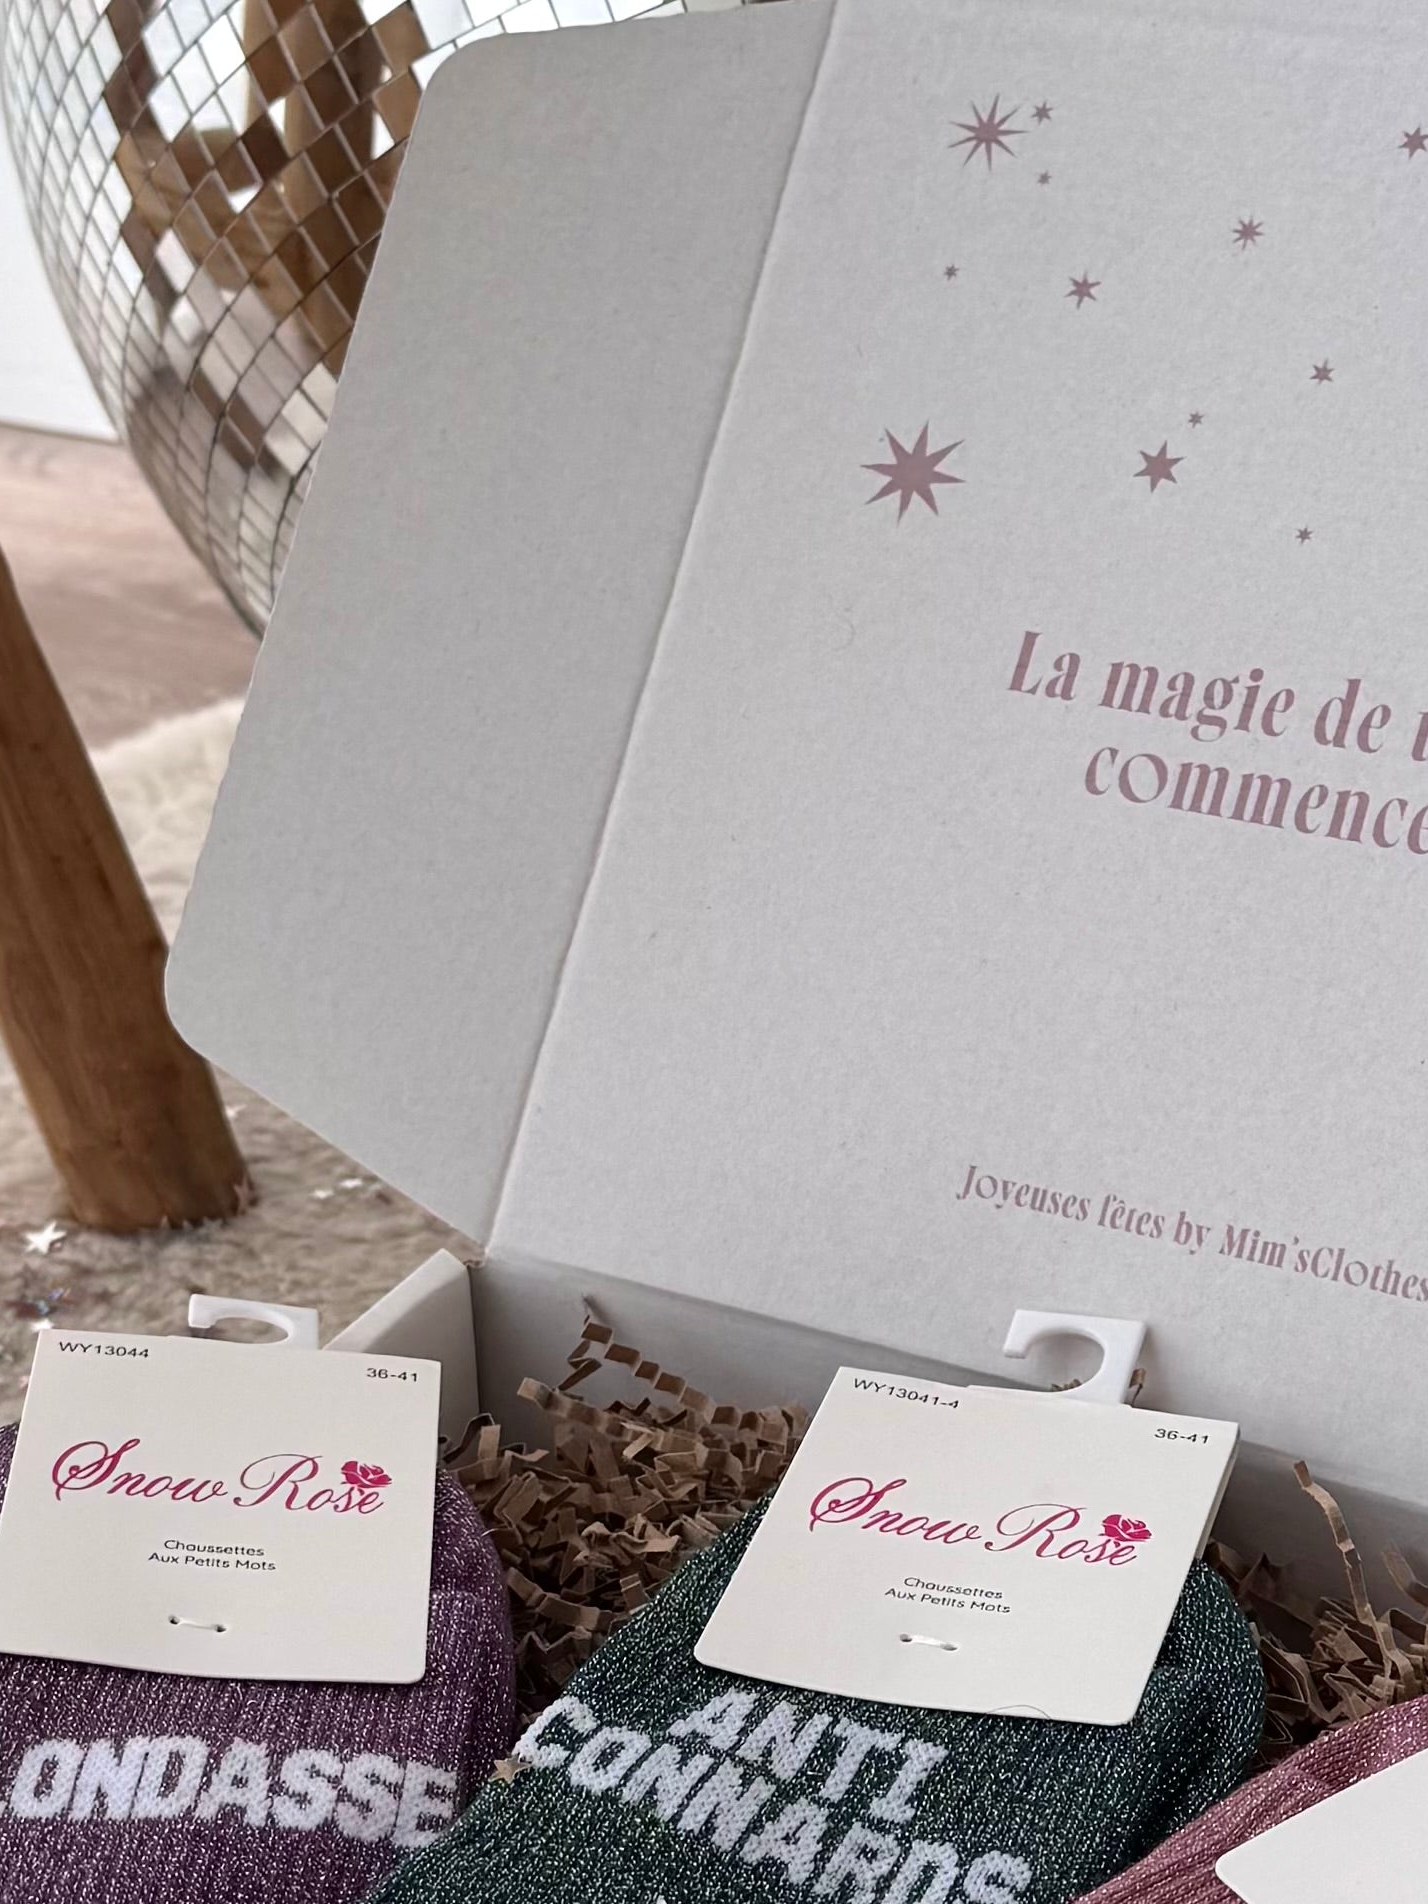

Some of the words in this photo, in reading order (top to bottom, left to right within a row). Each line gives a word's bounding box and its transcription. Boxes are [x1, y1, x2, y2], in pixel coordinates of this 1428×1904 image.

[1008, 630, 1082, 701] La
[1098, 658, 1296, 742] magie
[1313, 678, 1391, 754] de
[955, 1164, 1091, 1222] Joyeuses
[1096, 1193, 1166, 1240] fêtes
[1172, 1211, 1212, 1255] by
[59, 1341, 149, 1358] WY13044
[366, 1367, 418, 1382] 36-41
[854, 1377, 960, 1409] WY13041-4
[1154, 1428, 1209, 1444] 36-41
[51, 1437, 229, 1502] Snow
[232, 1453, 387, 1515] Rose
[809, 1477, 982, 1533] Snow
[984, 1503, 1139, 1567] Rose
[148, 1552, 179, 1564] Aux
[184, 1555, 230, 1568] Petits
[235, 1559, 277, 1571] Mots
[163, 1539, 265, 1557] Chaussettes
[884, 1587, 917, 1601] Aux
[920, 1593, 965, 1609] Petits
[970, 1601, 1011, 1614] Mots
[903, 1576, 1003, 1599] Chaussettes
[668, 1690, 947, 1823] ANTI
